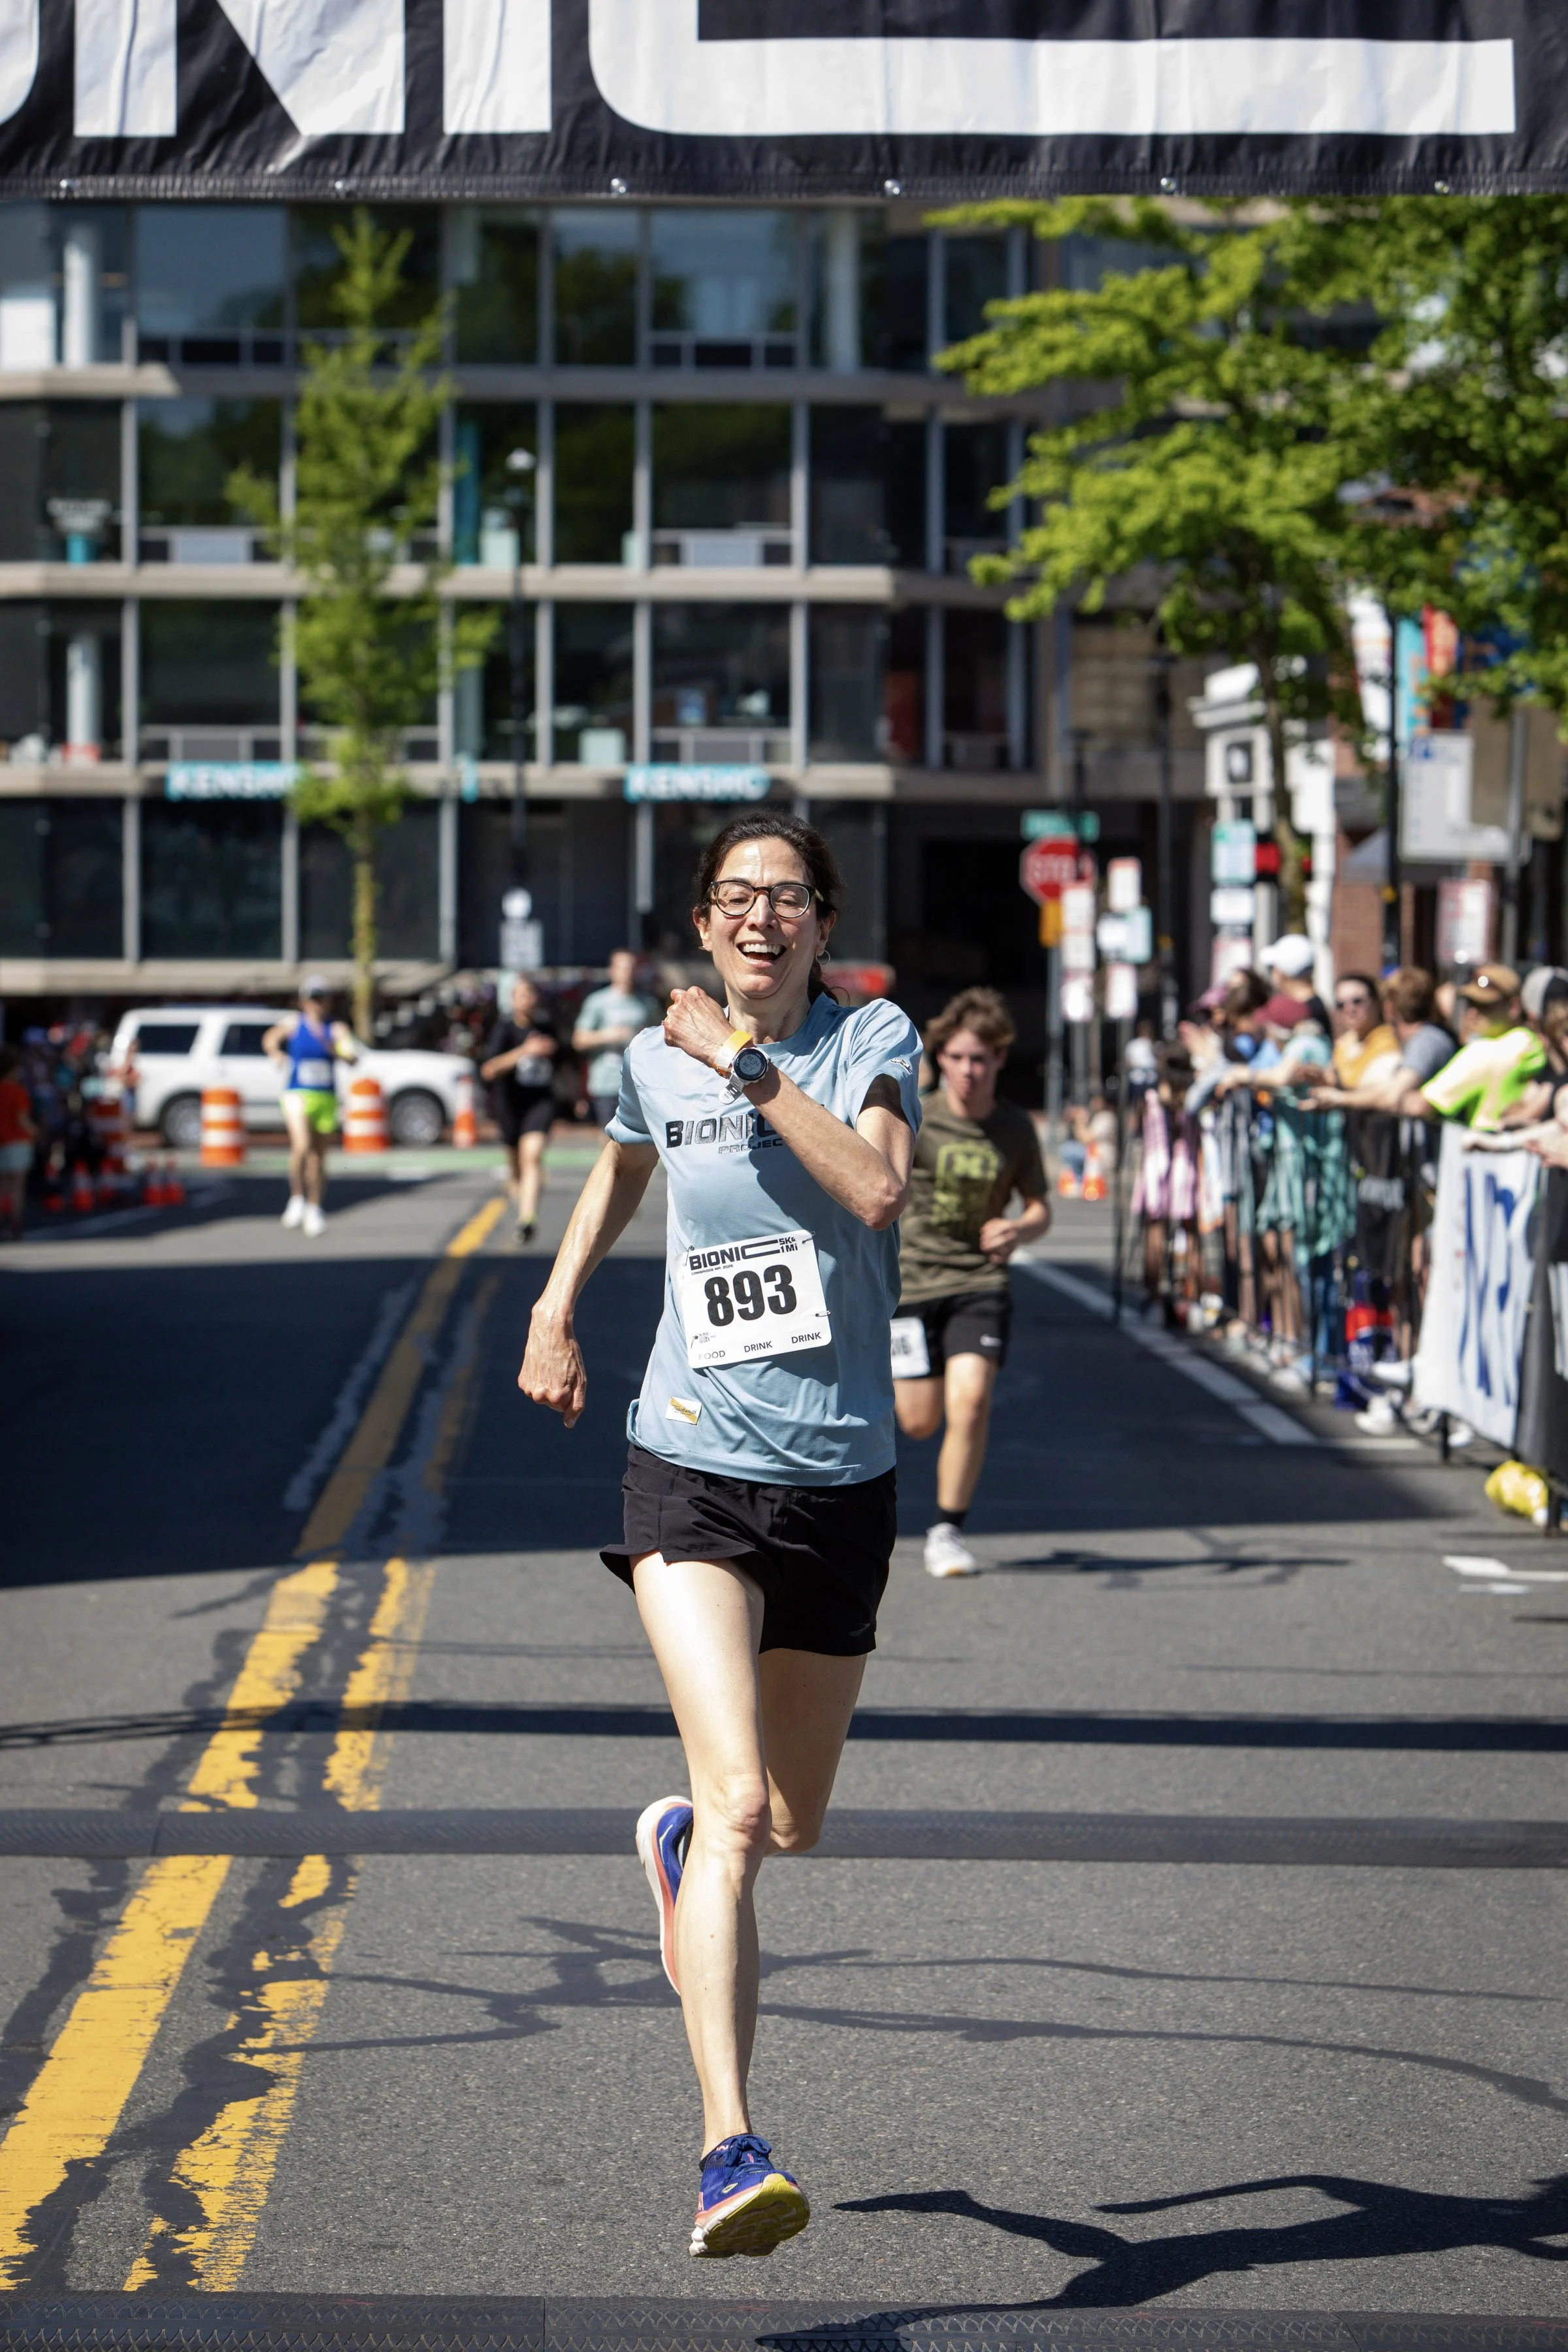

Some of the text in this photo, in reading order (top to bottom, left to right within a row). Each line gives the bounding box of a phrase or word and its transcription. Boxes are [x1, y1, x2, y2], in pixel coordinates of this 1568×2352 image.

[718, 1138, 783, 1154] PROJEC
[779, 1237, 796, 1245] 5K&
[689, 1239, 781, 1271] BIONIC
[779, 1243, 798, 1254] 1Mi
[704, 1264, 797, 1326] 893
[791, 1331, 822, 1345] DRINK
[743, 1340, 774, 1353] DRINK
